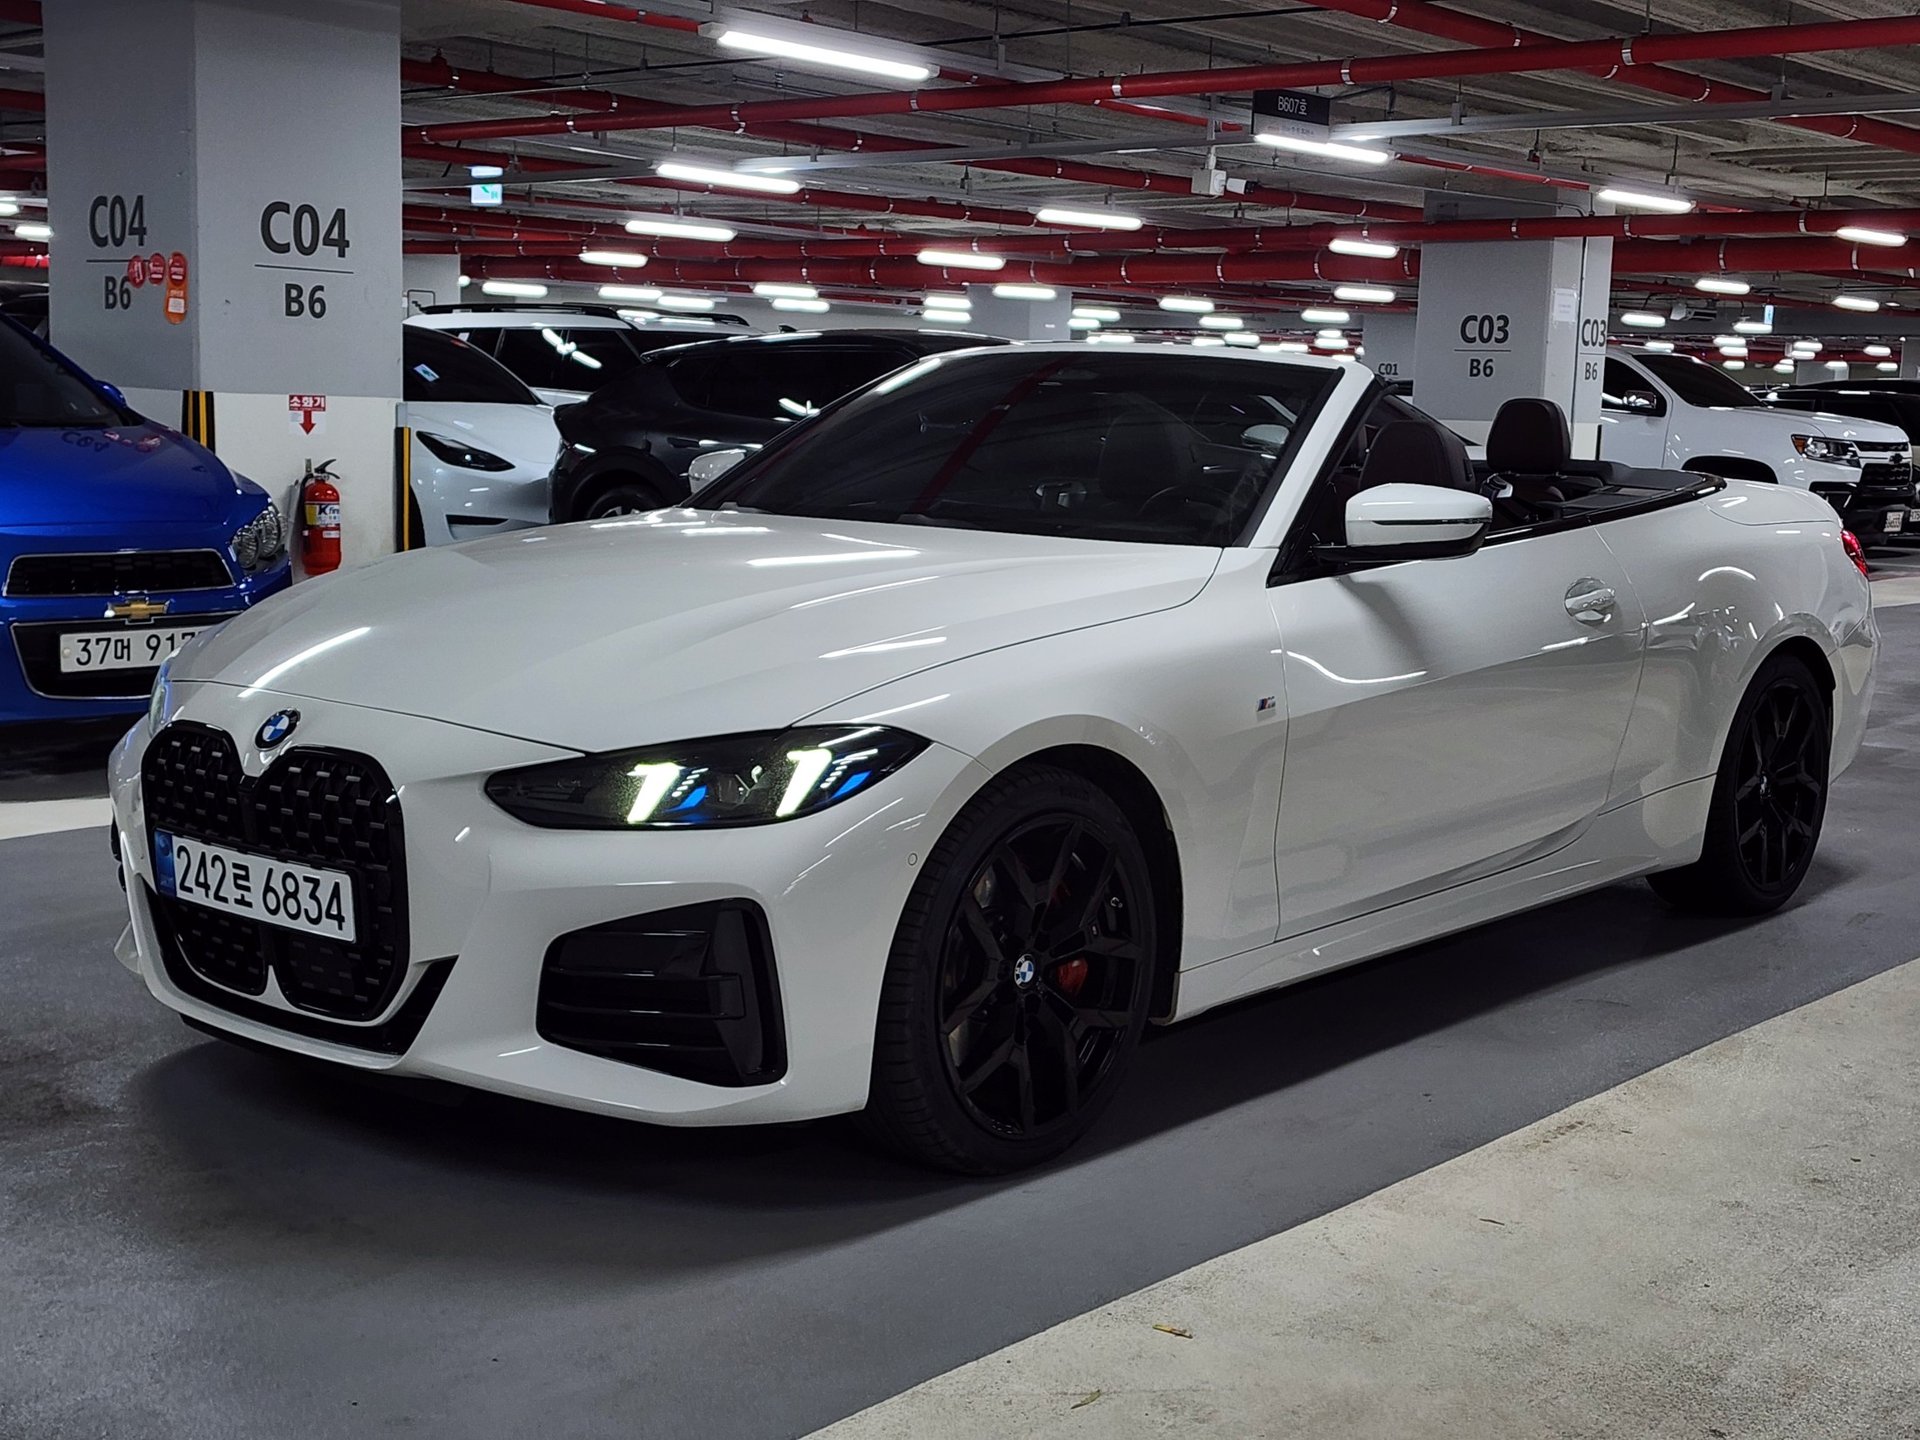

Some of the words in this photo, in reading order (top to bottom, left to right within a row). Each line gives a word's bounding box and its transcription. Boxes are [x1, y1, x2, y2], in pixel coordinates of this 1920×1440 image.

[1278, 95, 1307, 115] B607호
[89, 194, 147, 248] C04
[259, 201, 350, 259] C04
[104, 276, 131, 310] B6
[284, 283, 327, 319] B6
[1459, 314, 1510, 345] C03
[1582, 318, 1607, 348] C03
[1378, 363, 1399, 375] C01
[1468, 358, 1494, 377] B6
[1584, 362, 1598, 380] B6
[290, 396, 325, 407] 소화기
[75, 637, 131, 666] 37머
[176, 845, 253, 908] 242로
[262, 868, 346, 931] 6834
